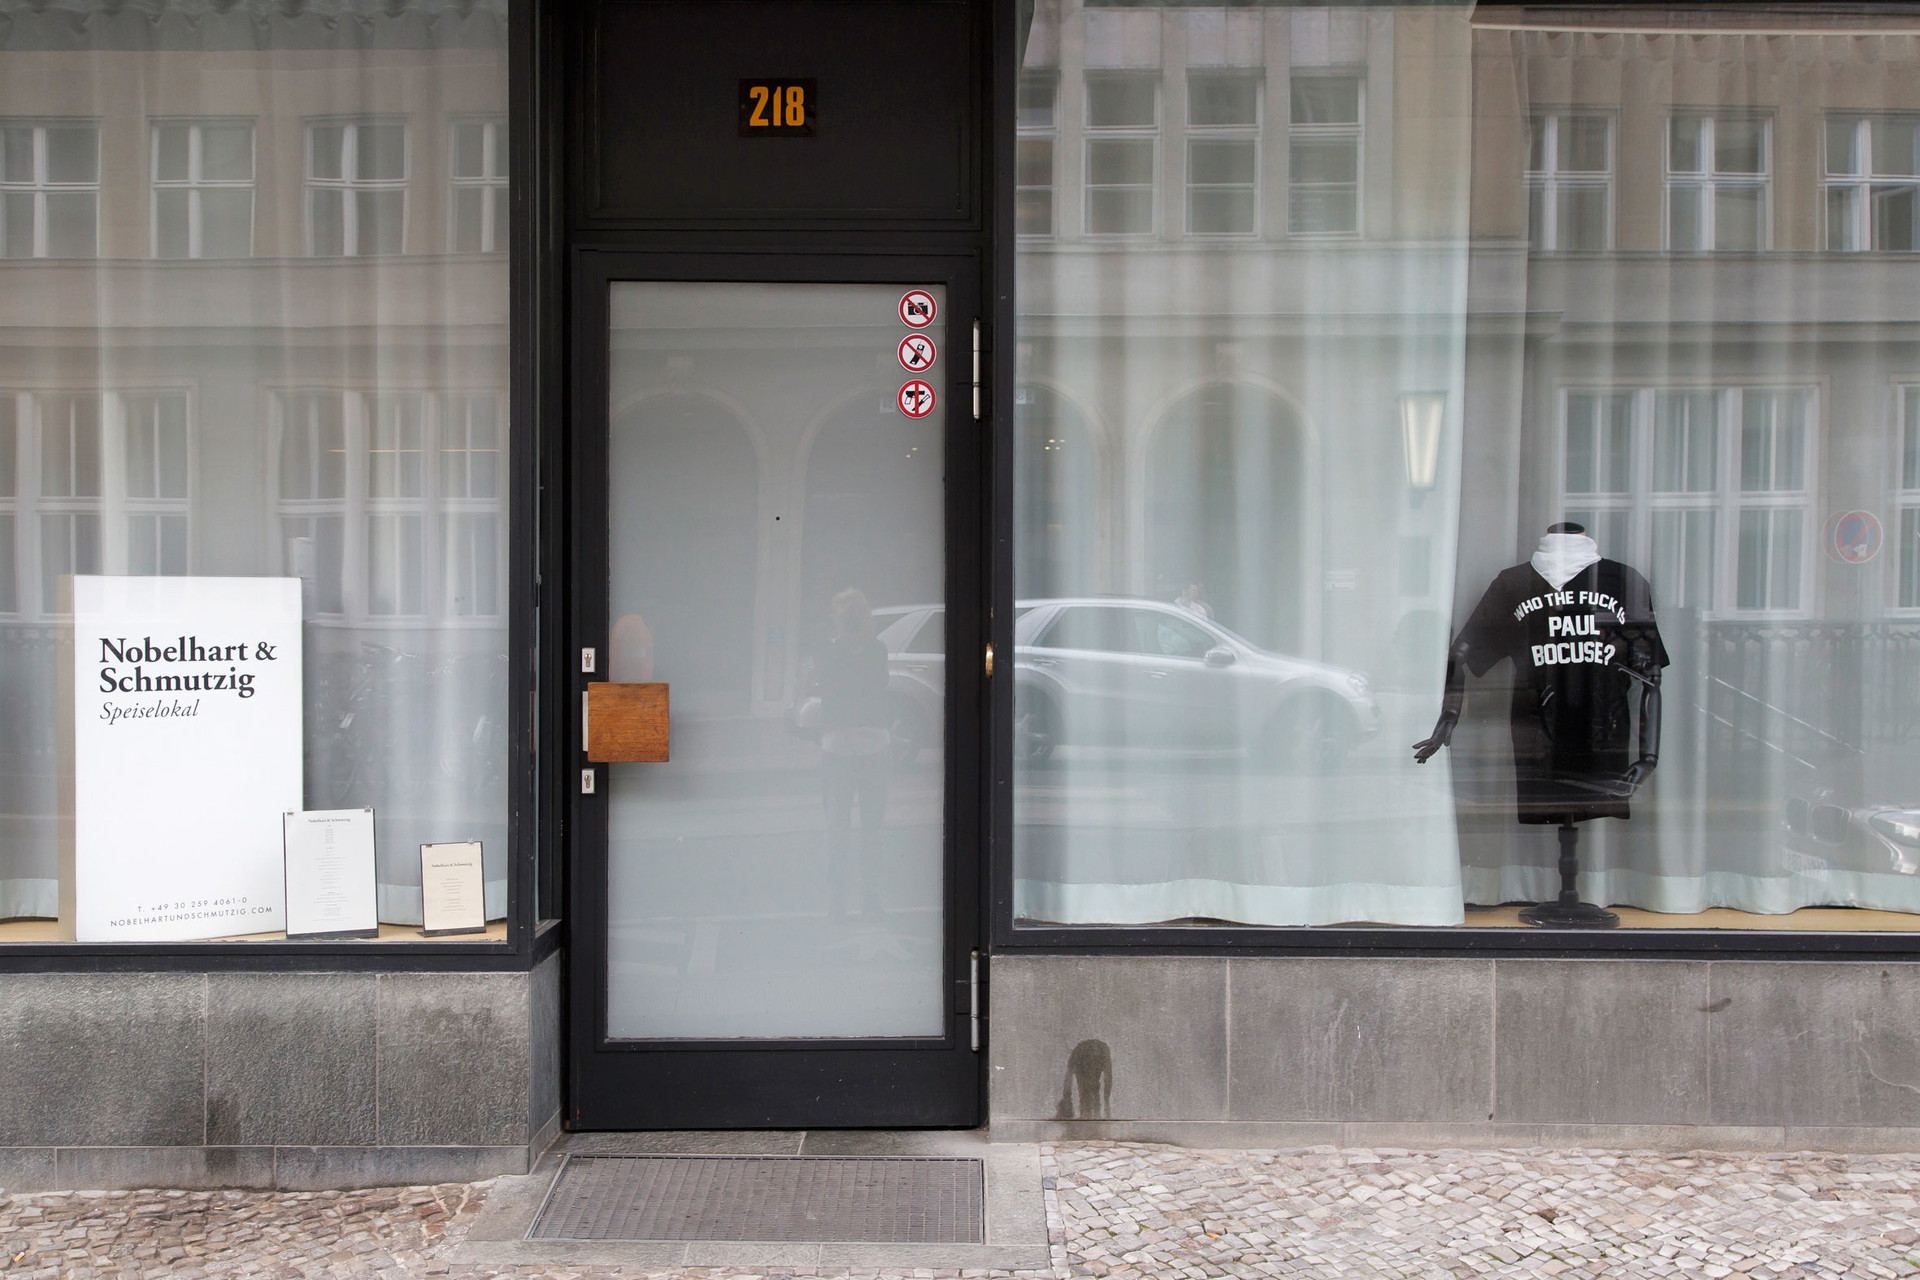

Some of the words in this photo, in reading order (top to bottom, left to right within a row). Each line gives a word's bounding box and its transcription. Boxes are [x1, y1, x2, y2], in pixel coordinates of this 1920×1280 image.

[750, 86, 804, 126] 218
[1514, 597, 1544, 622] WHO
[1544, 591, 1575, 607] THE
[1579, 591, 1618, 613] FUCK
[1616, 606, 1626, 625] IS
[1548, 614, 1600, 637] PAUL
[99, 636, 248, 663] Nobelhart
[255, 641, 278, 661] &
[1531, 641, 1616, 667] BOCUSE?
[100, 666, 255, 698] Schmutzig
[100, 699, 200, 725] Speiselokal
[191, 900, 208, 908] 259
[213, 896, 248, 906] 4061-0
[110, 906, 273, 927] NOBELHARTUNDSCHMUTZIG.COM
